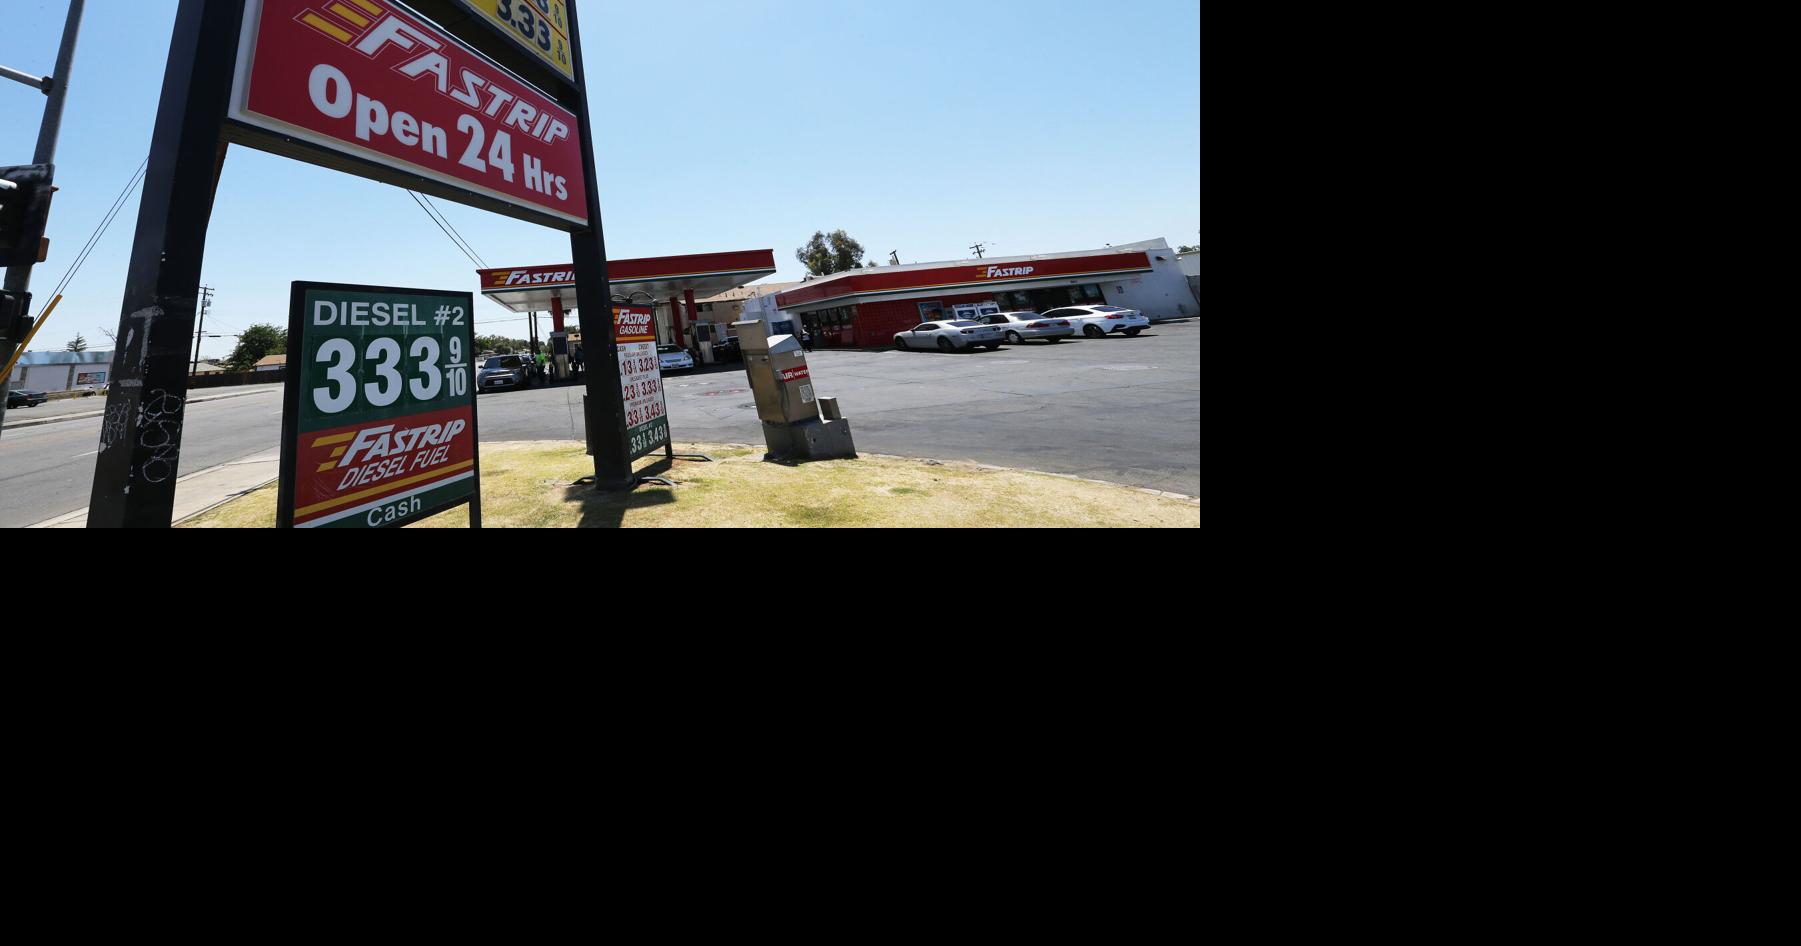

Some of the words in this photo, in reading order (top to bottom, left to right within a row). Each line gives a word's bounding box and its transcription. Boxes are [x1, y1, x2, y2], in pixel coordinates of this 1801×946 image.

[354, 15, 568, 142] FASTRIP
[308, 64, 447, 160] Open
[456, 114, 515, 183] 24
[523, 153, 568, 201] Hrs
[504, 269, 575, 286] FASTRI
[986, 265, 1034, 278] FASTRIP
[313, 300, 427, 326] DIESEL
[433, 304, 465, 326] #2
[617, 309, 651, 325] FASTRIP
[620, 325, 649, 335] GASOLINE
[338, 418, 466, 468] FASTRIP
[336, 454, 407, 491] DIESEL
[410, 445, 451, 472] FUEL
[367, 495, 421, 527] Cash
